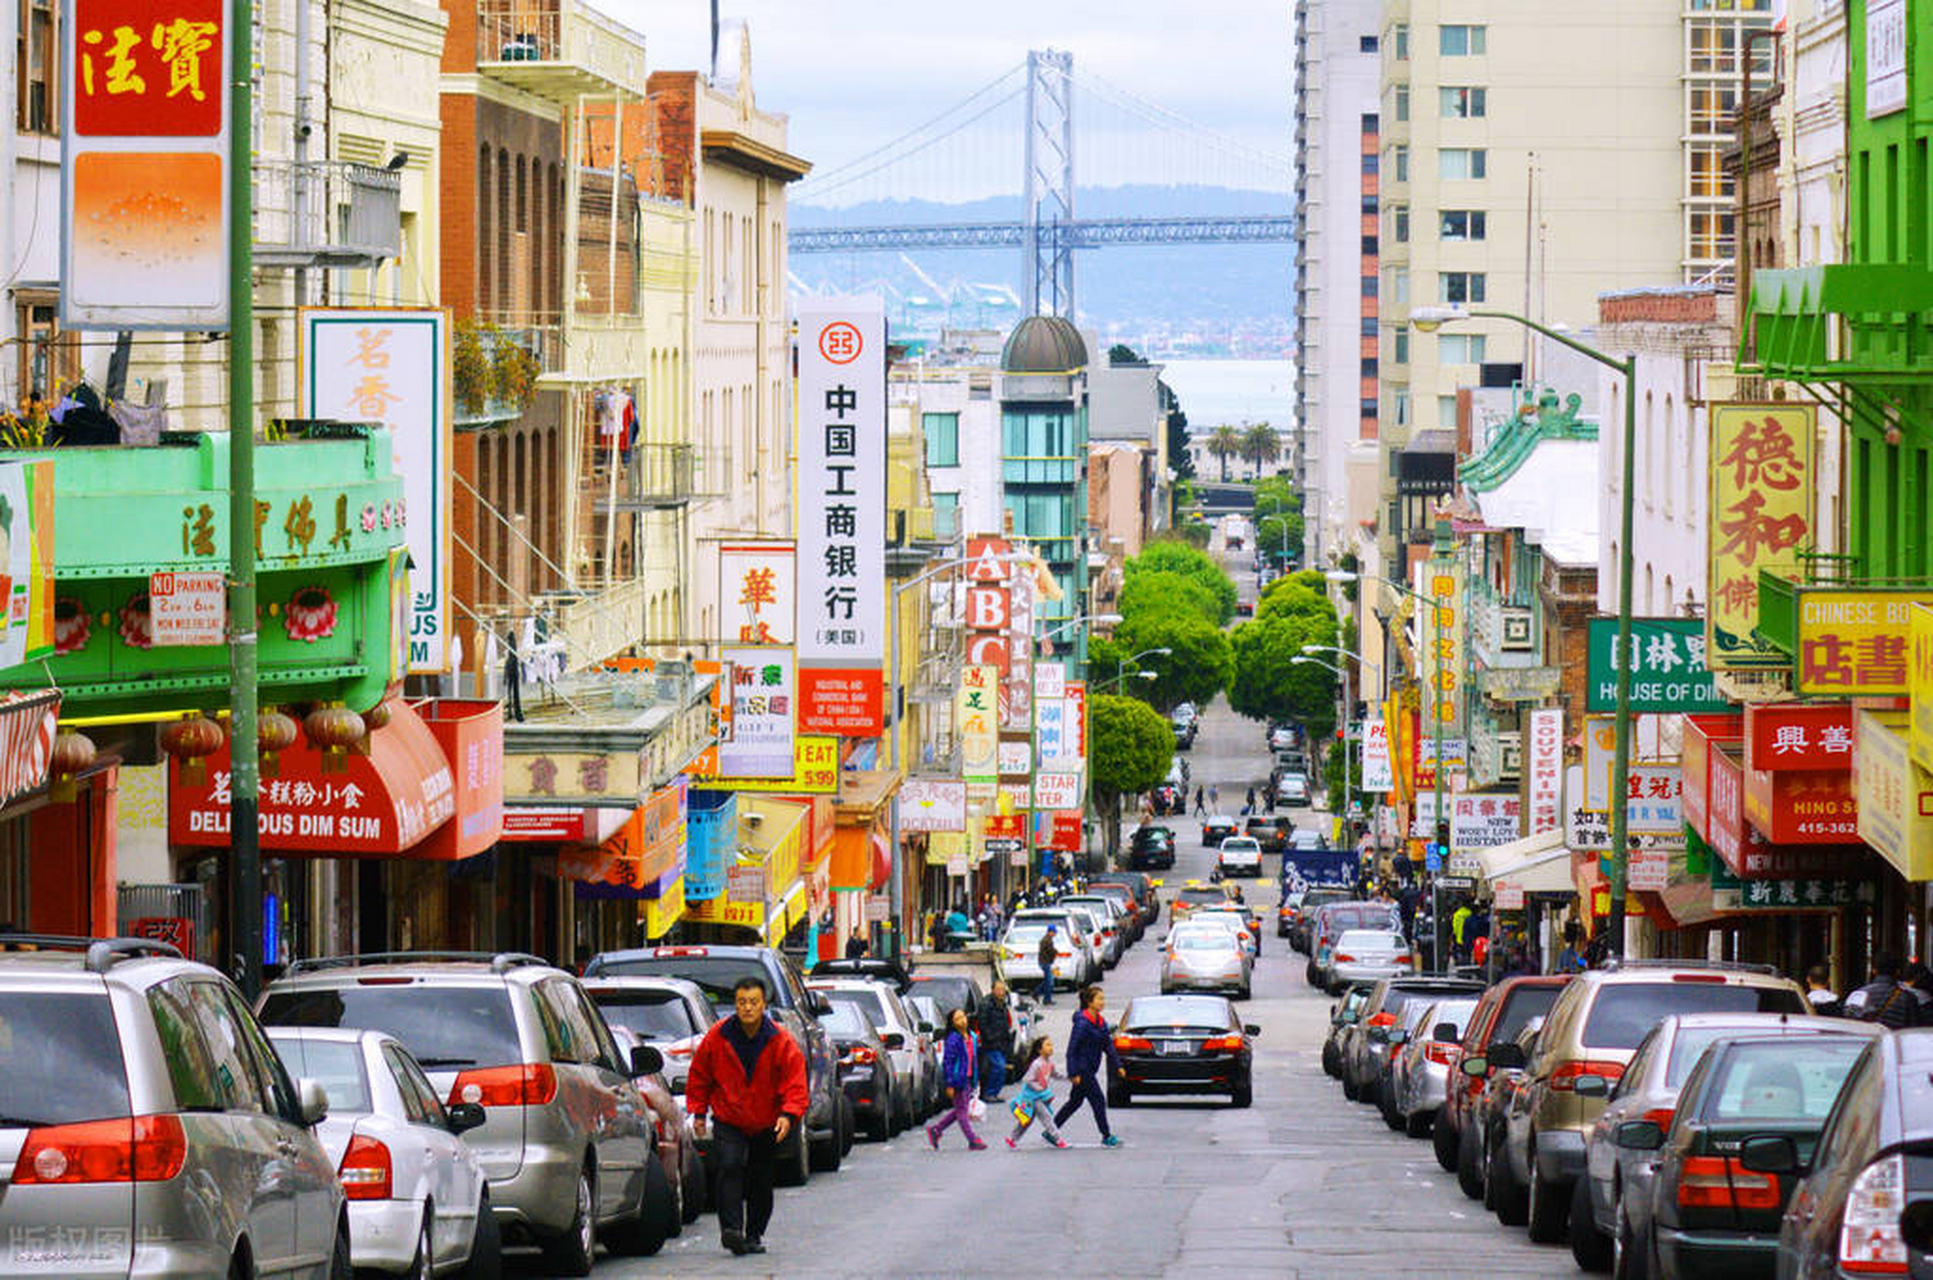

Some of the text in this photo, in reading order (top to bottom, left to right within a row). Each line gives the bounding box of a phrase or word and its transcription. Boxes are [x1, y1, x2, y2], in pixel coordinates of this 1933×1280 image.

[825, 384, 858, 619] 中国工商银行
[1718, 416, 1808, 567] 德和
[154, 575, 222, 594] NO PARKING
[1804, 602, 1879, 625] CHINESE
[1666, 682, 1690, 702] OF
[806, 745, 833, 763] EAT
[1041, 777, 1075, 793] STAR
[1793, 801, 1837, 816] HING
[300, 814, 334, 836] DIM
[339, 817, 380, 840] SUM
